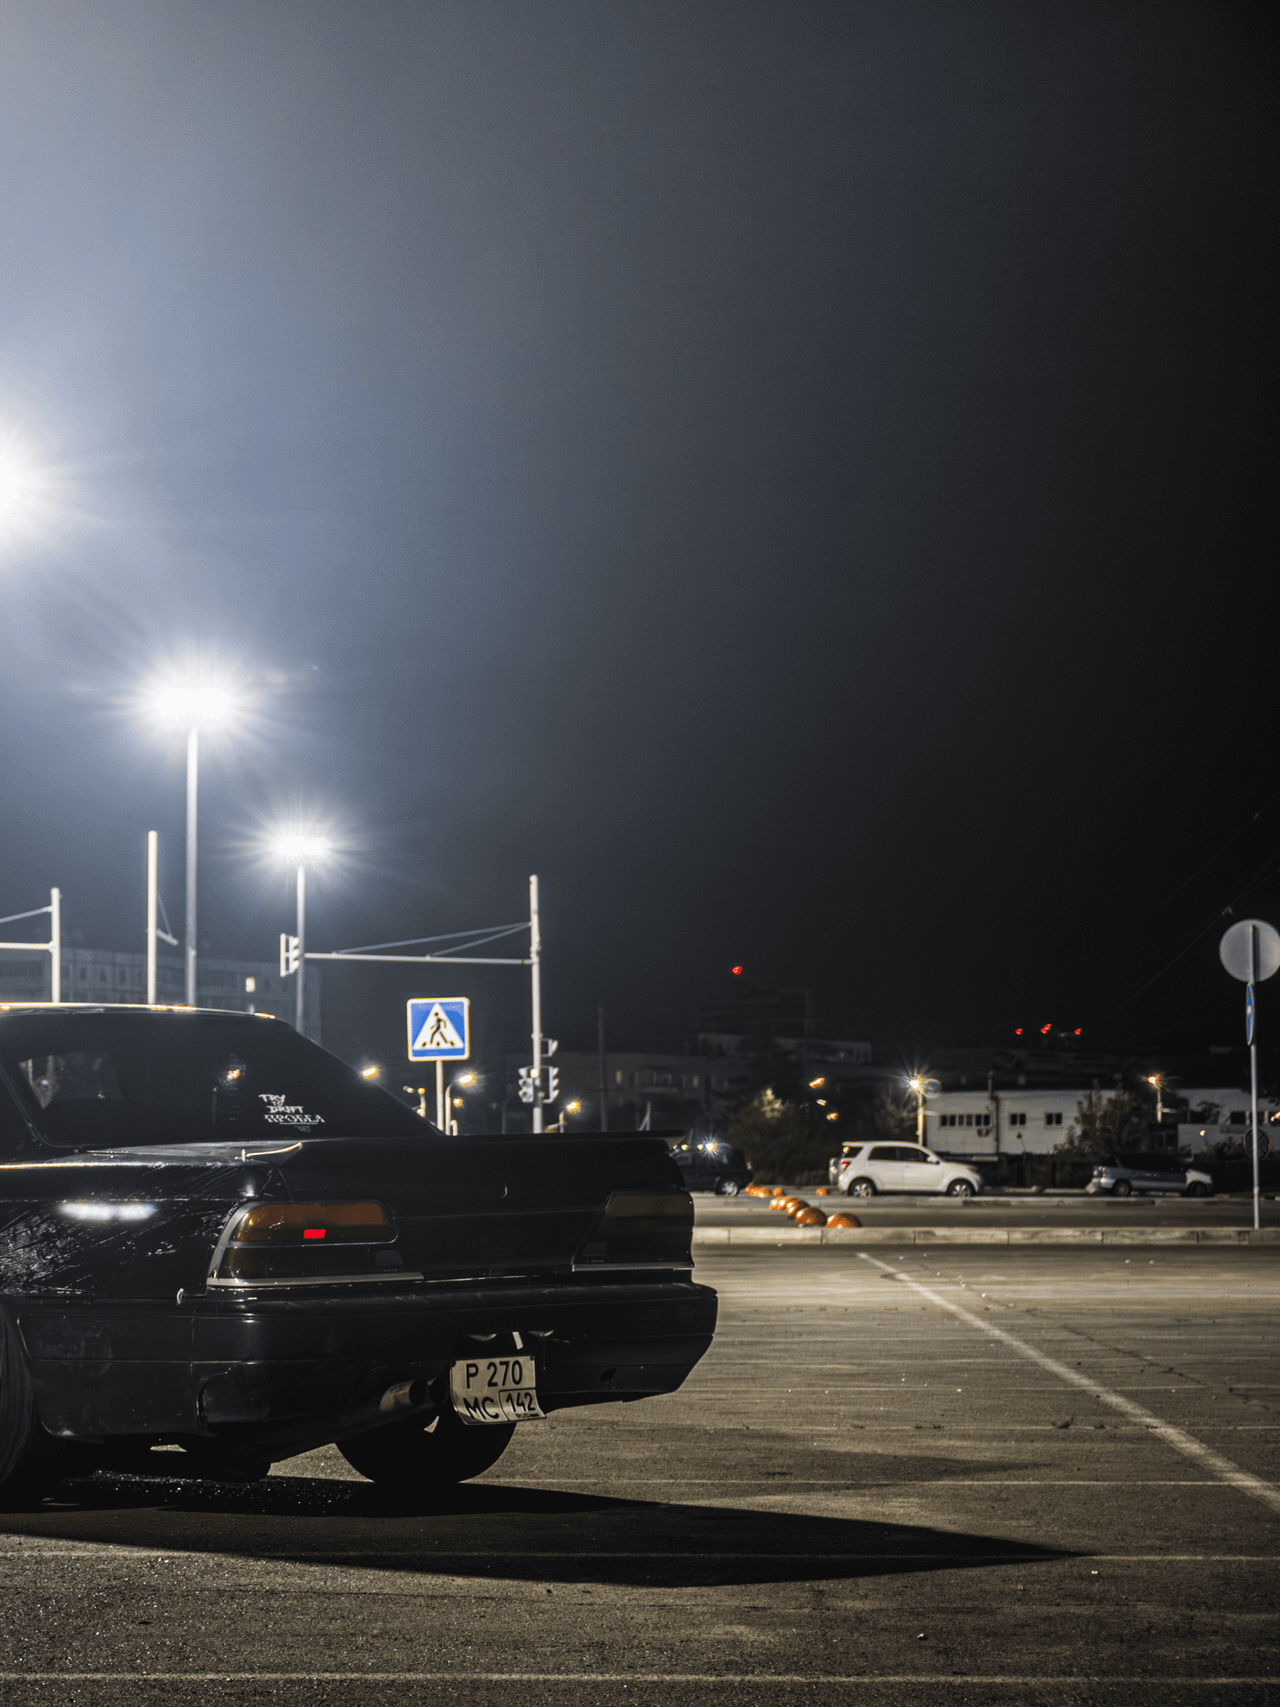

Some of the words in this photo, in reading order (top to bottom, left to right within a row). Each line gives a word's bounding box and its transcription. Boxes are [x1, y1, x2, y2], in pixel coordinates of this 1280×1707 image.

[266, 1105, 304, 1114] DRIFT
[486, 1360, 523, 1388] 270
[506, 1392, 536, 1412] 142
